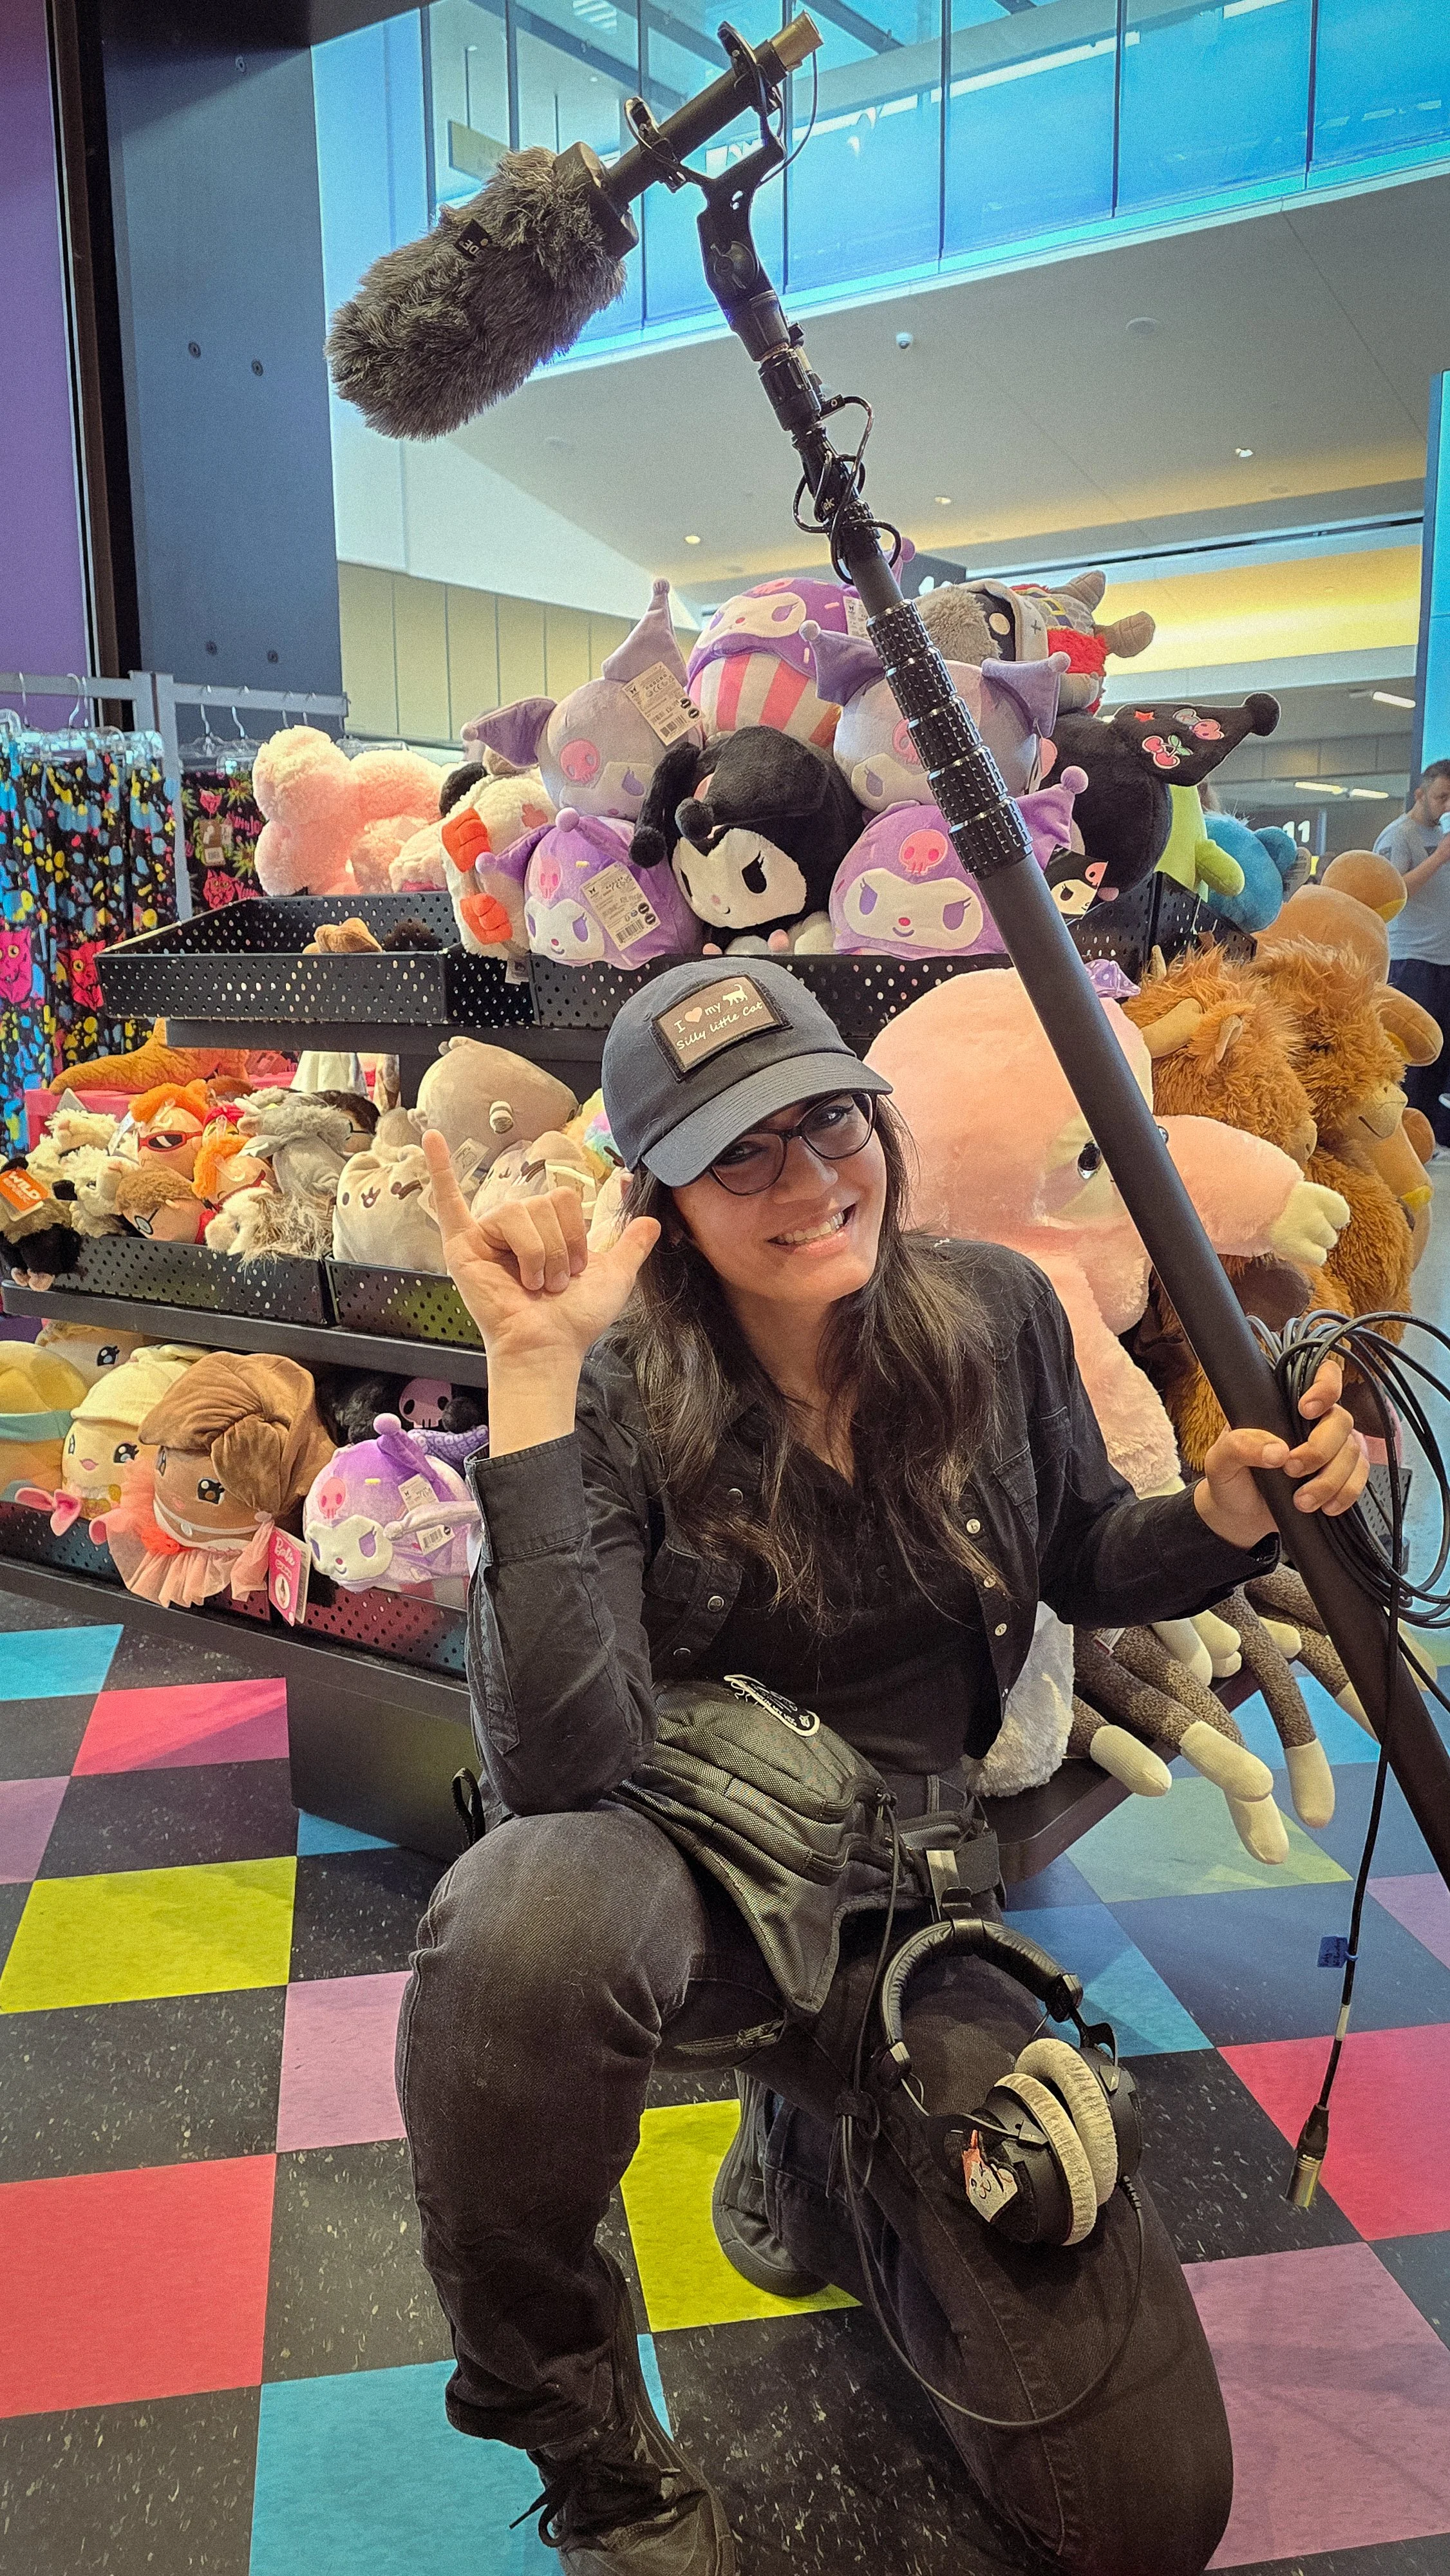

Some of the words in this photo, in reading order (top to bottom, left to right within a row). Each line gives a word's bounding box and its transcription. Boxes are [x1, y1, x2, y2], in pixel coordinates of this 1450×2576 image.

[1283, 820, 1310, 843] 11
[674, 1019, 686, 1033] I
[704, 1002, 721, 1016] my
[676, 1030, 706, 1050] Silly
[742, 1001, 763, 1016] Cat
[8, 1171, 42, 1200] WILD
